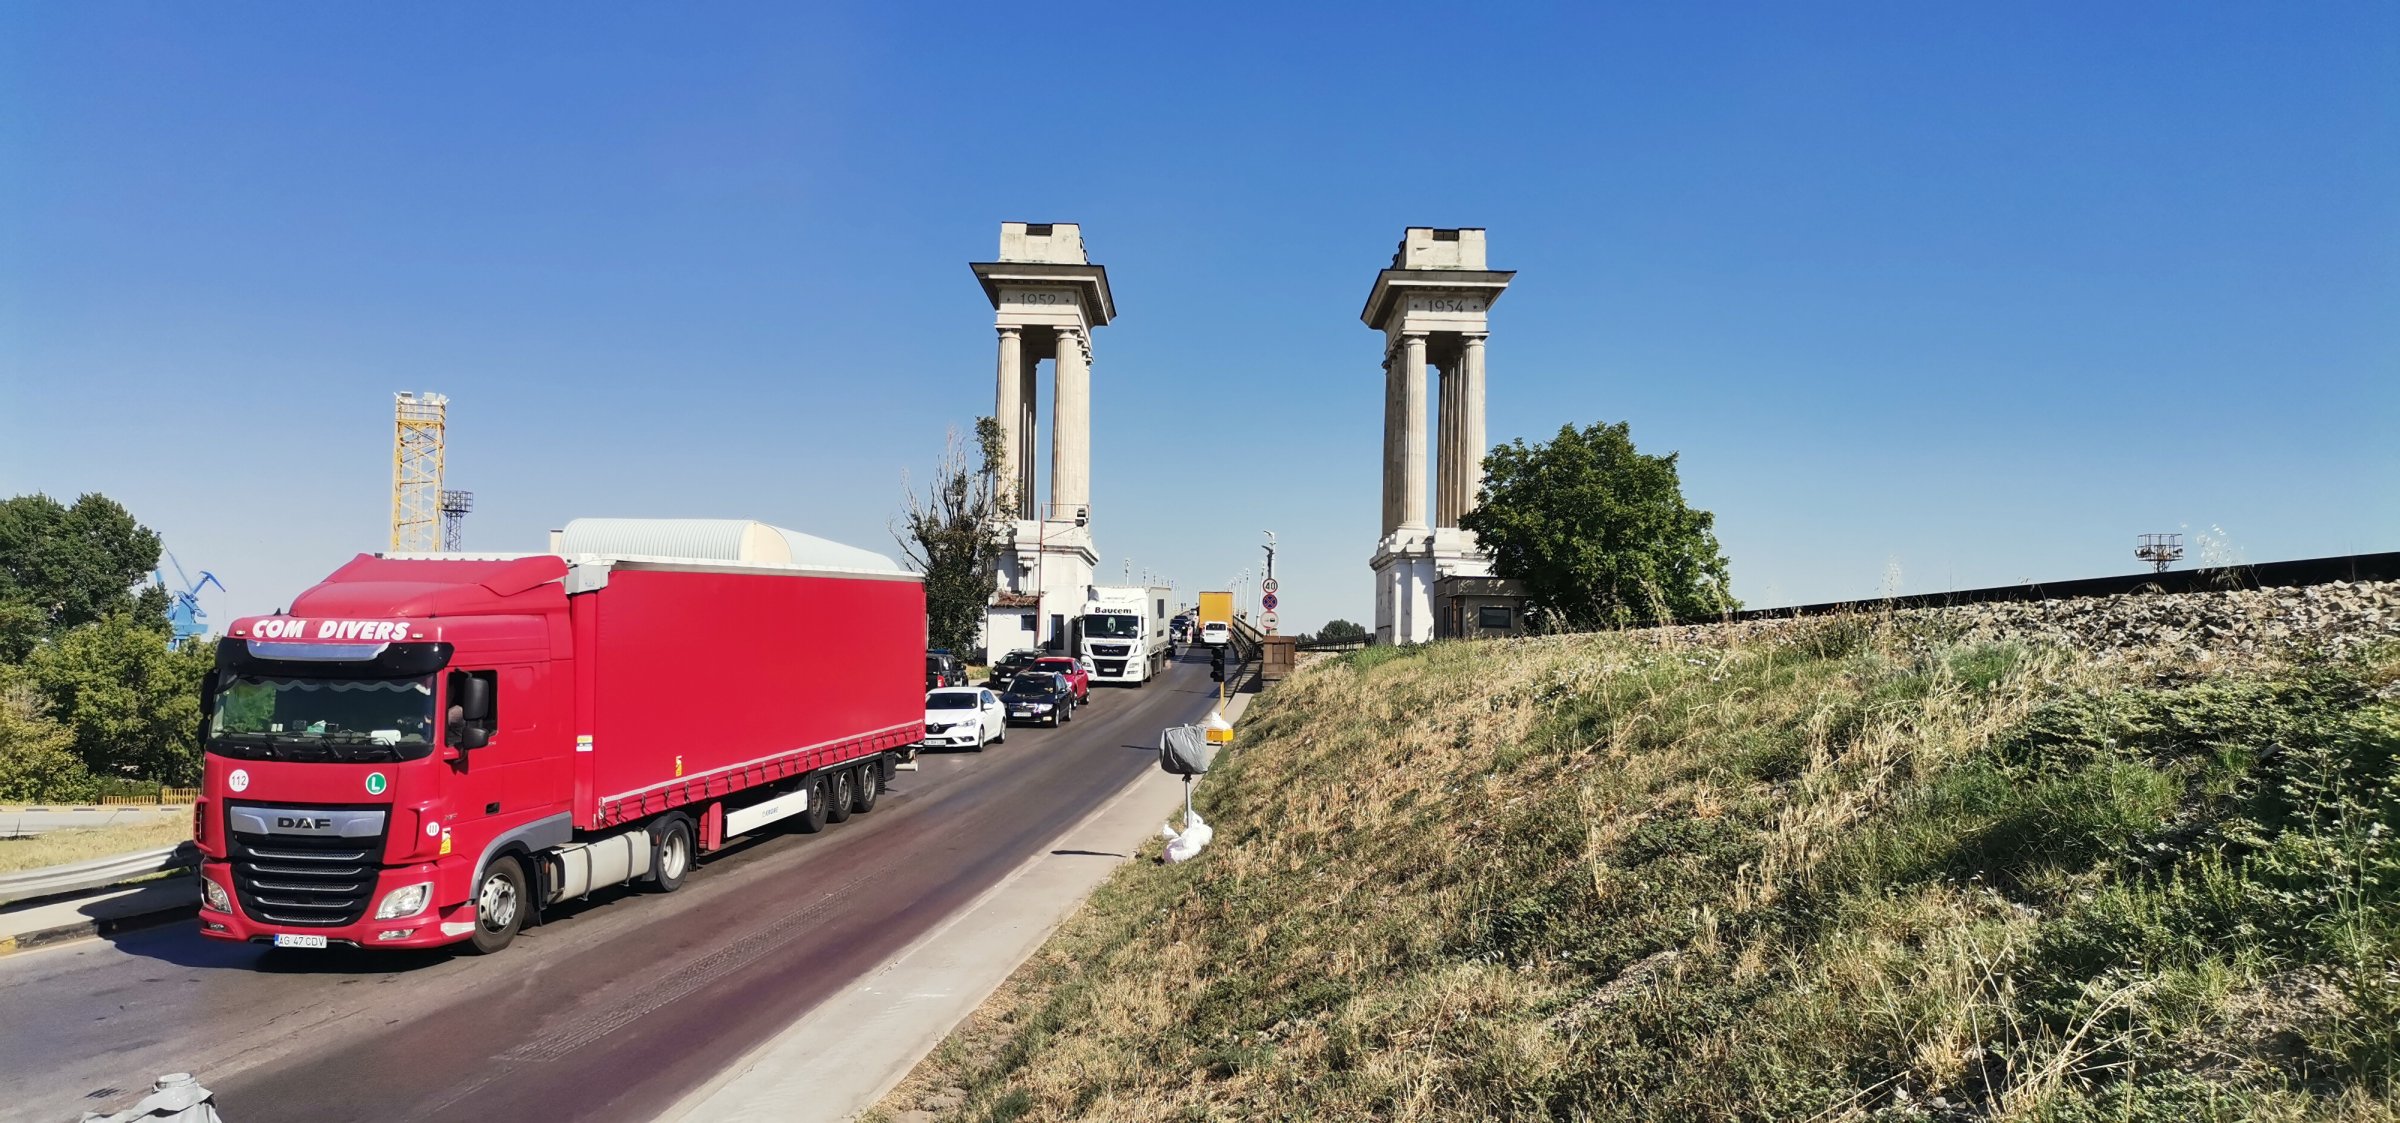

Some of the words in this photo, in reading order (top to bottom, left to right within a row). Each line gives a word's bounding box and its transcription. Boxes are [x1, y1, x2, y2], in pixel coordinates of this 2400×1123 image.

[1020, 293, 1056, 306] 1952
[1428, 300, 1464, 312] 1954
[1265, 582, 1276, 590] 40
[1094, 606, 1132, 614] Baucem
[252, 619, 307, 638] COM
[318, 620, 411, 641] DIVERS
[231, 775, 247, 786] 112
[371, 776, 381, 791] L
[277, 817, 331, 830] DAF
[280, 936, 290, 946] AG
[293, 936, 304, 946] 47
[305, 937, 325, 947] CDV
